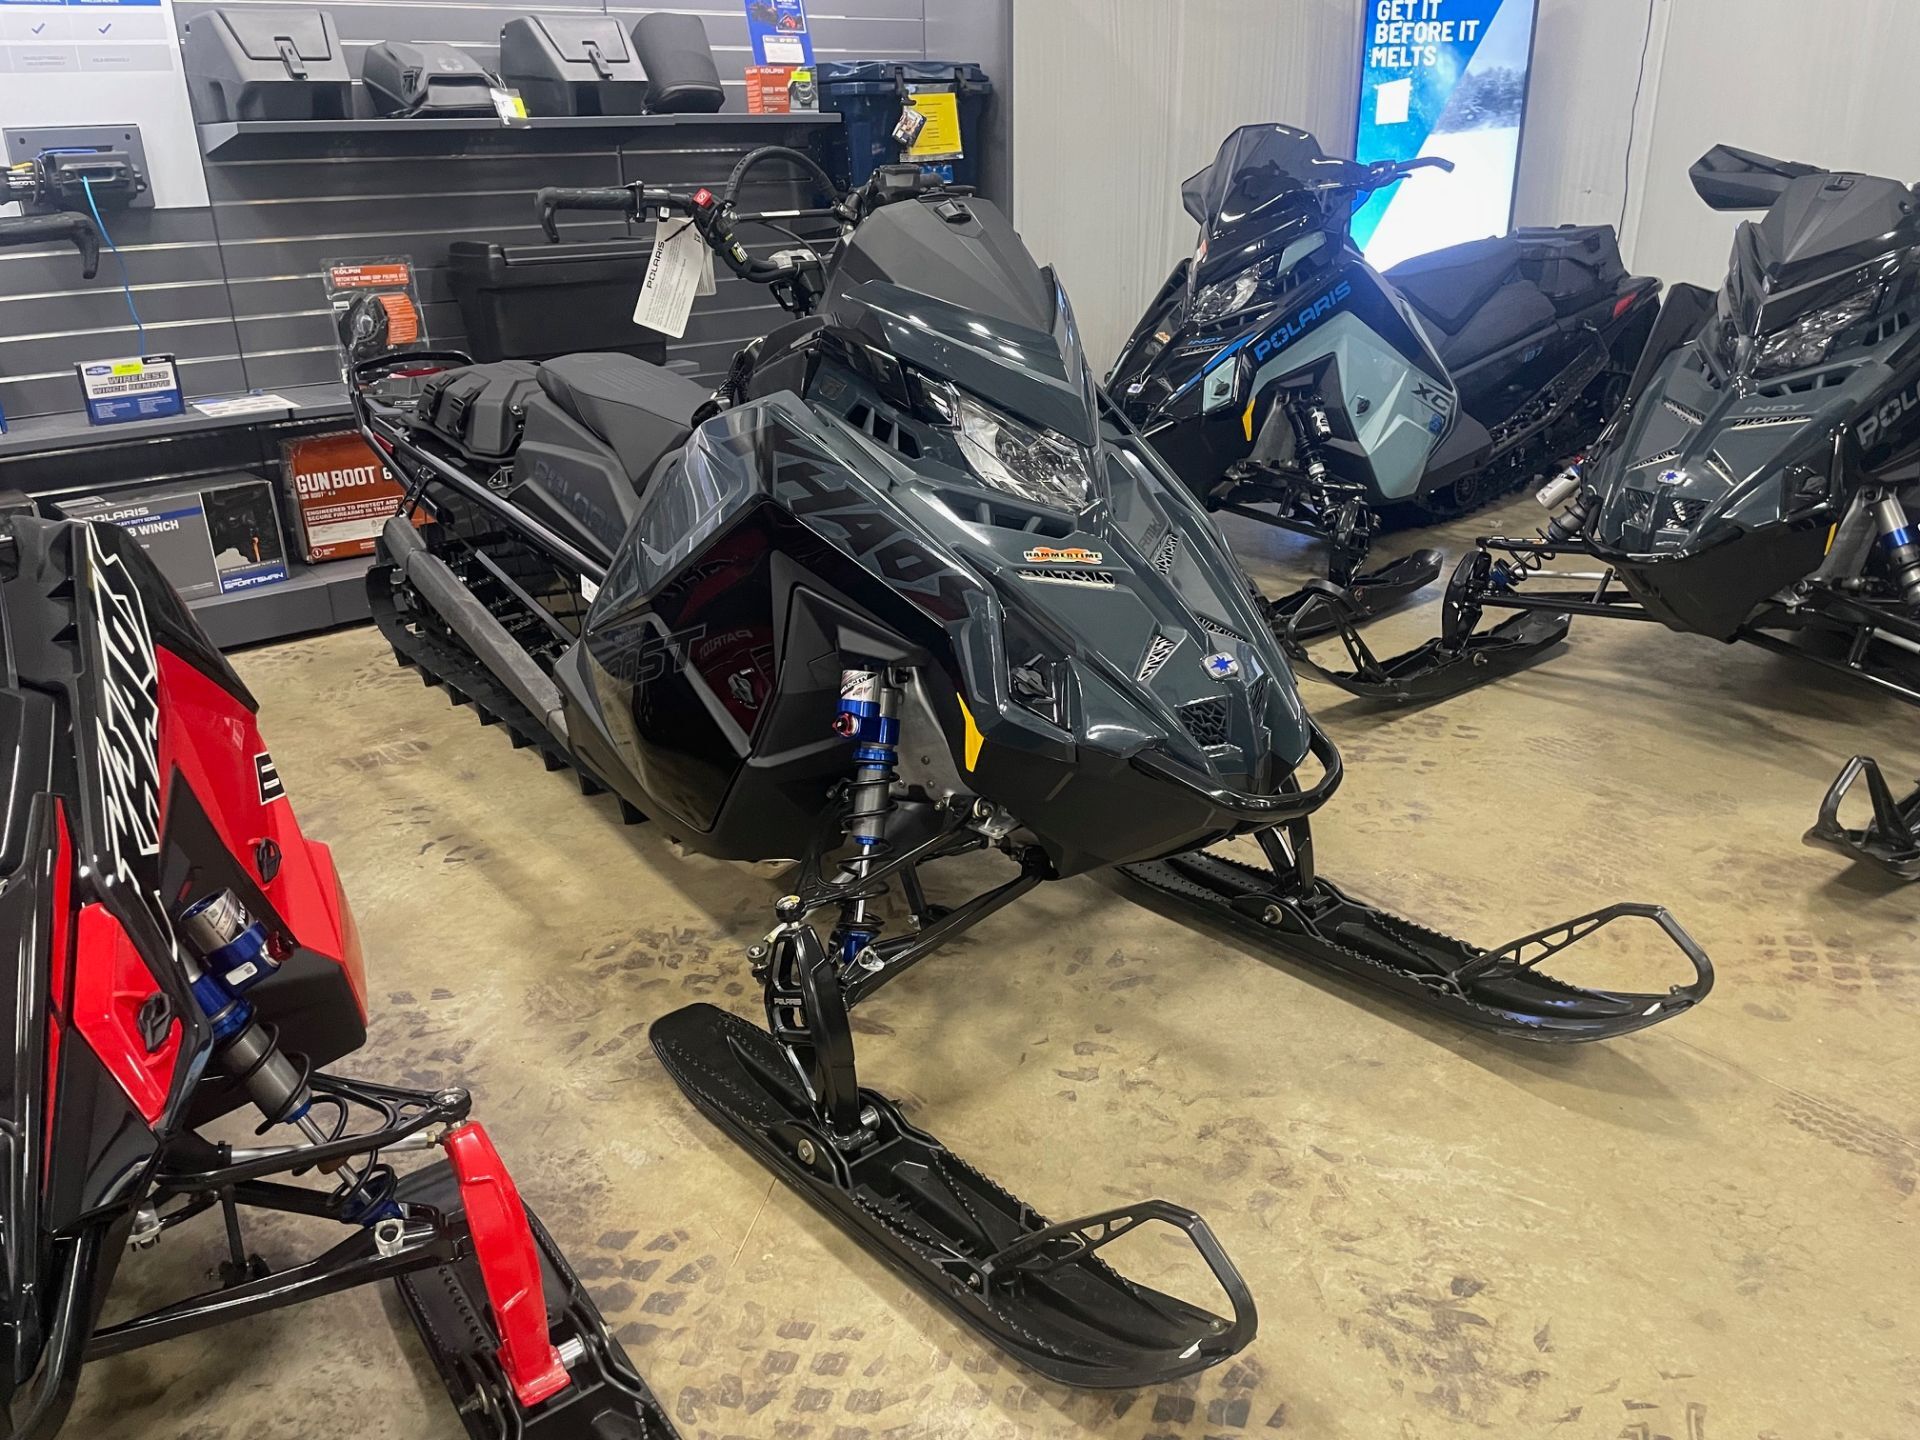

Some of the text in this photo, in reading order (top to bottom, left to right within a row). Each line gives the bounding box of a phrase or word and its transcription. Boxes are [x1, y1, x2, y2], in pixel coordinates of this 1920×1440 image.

[1377, 0, 1443, 21] GET IT
[1374, 20, 1480, 44] BEFORE IT
[1370, 45, 1437, 68] MELTS
[646, 241, 666, 289] POLARIS
[1254, 280, 1351, 362] POLARIS
[1411, 382, 1451, 411] XC
[1744, 403, 1805, 414] INDY
[296, 471, 331, 493] GUN
[330, 466, 375, 489] BOOT
[306, 507, 346, 516] ENGINEERED
[356, 501, 384, 509] PROTECT
[307, 513, 333, 521] SECURE
[333, 508, 365, 517] FIREARMS
[138, 520, 180, 535] WINCH
[224, 572, 284, 590] SPORTSMAN
